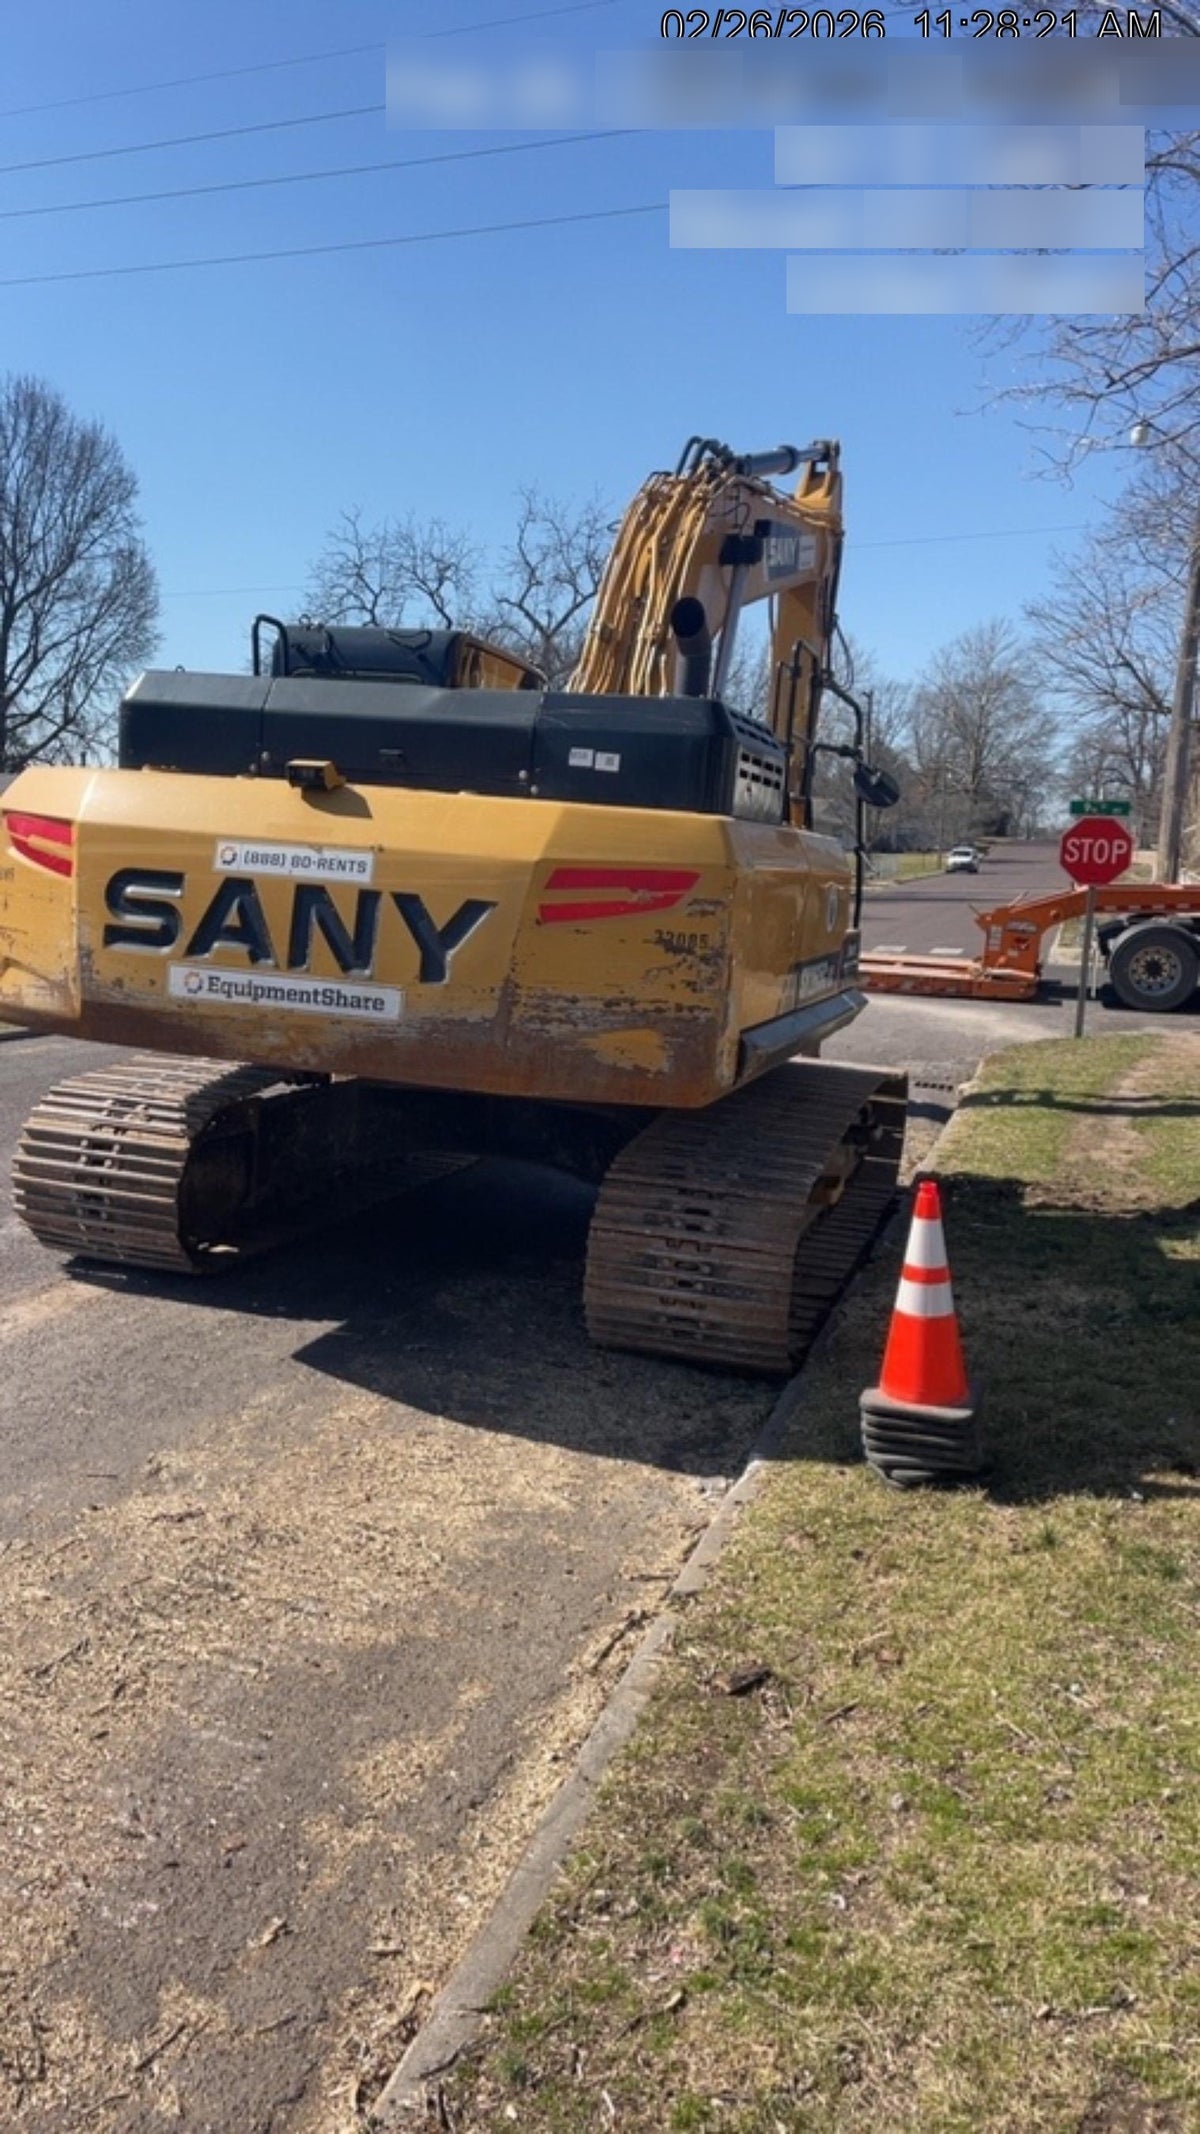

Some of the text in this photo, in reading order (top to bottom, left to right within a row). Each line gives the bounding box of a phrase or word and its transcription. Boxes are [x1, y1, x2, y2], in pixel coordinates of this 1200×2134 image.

[244, 850, 286, 868] (888)
[1064, 837, 1128, 864] STOP
[104, 867, 499, 985] SANY
[207, 975, 386, 1012] EquipmentShare
